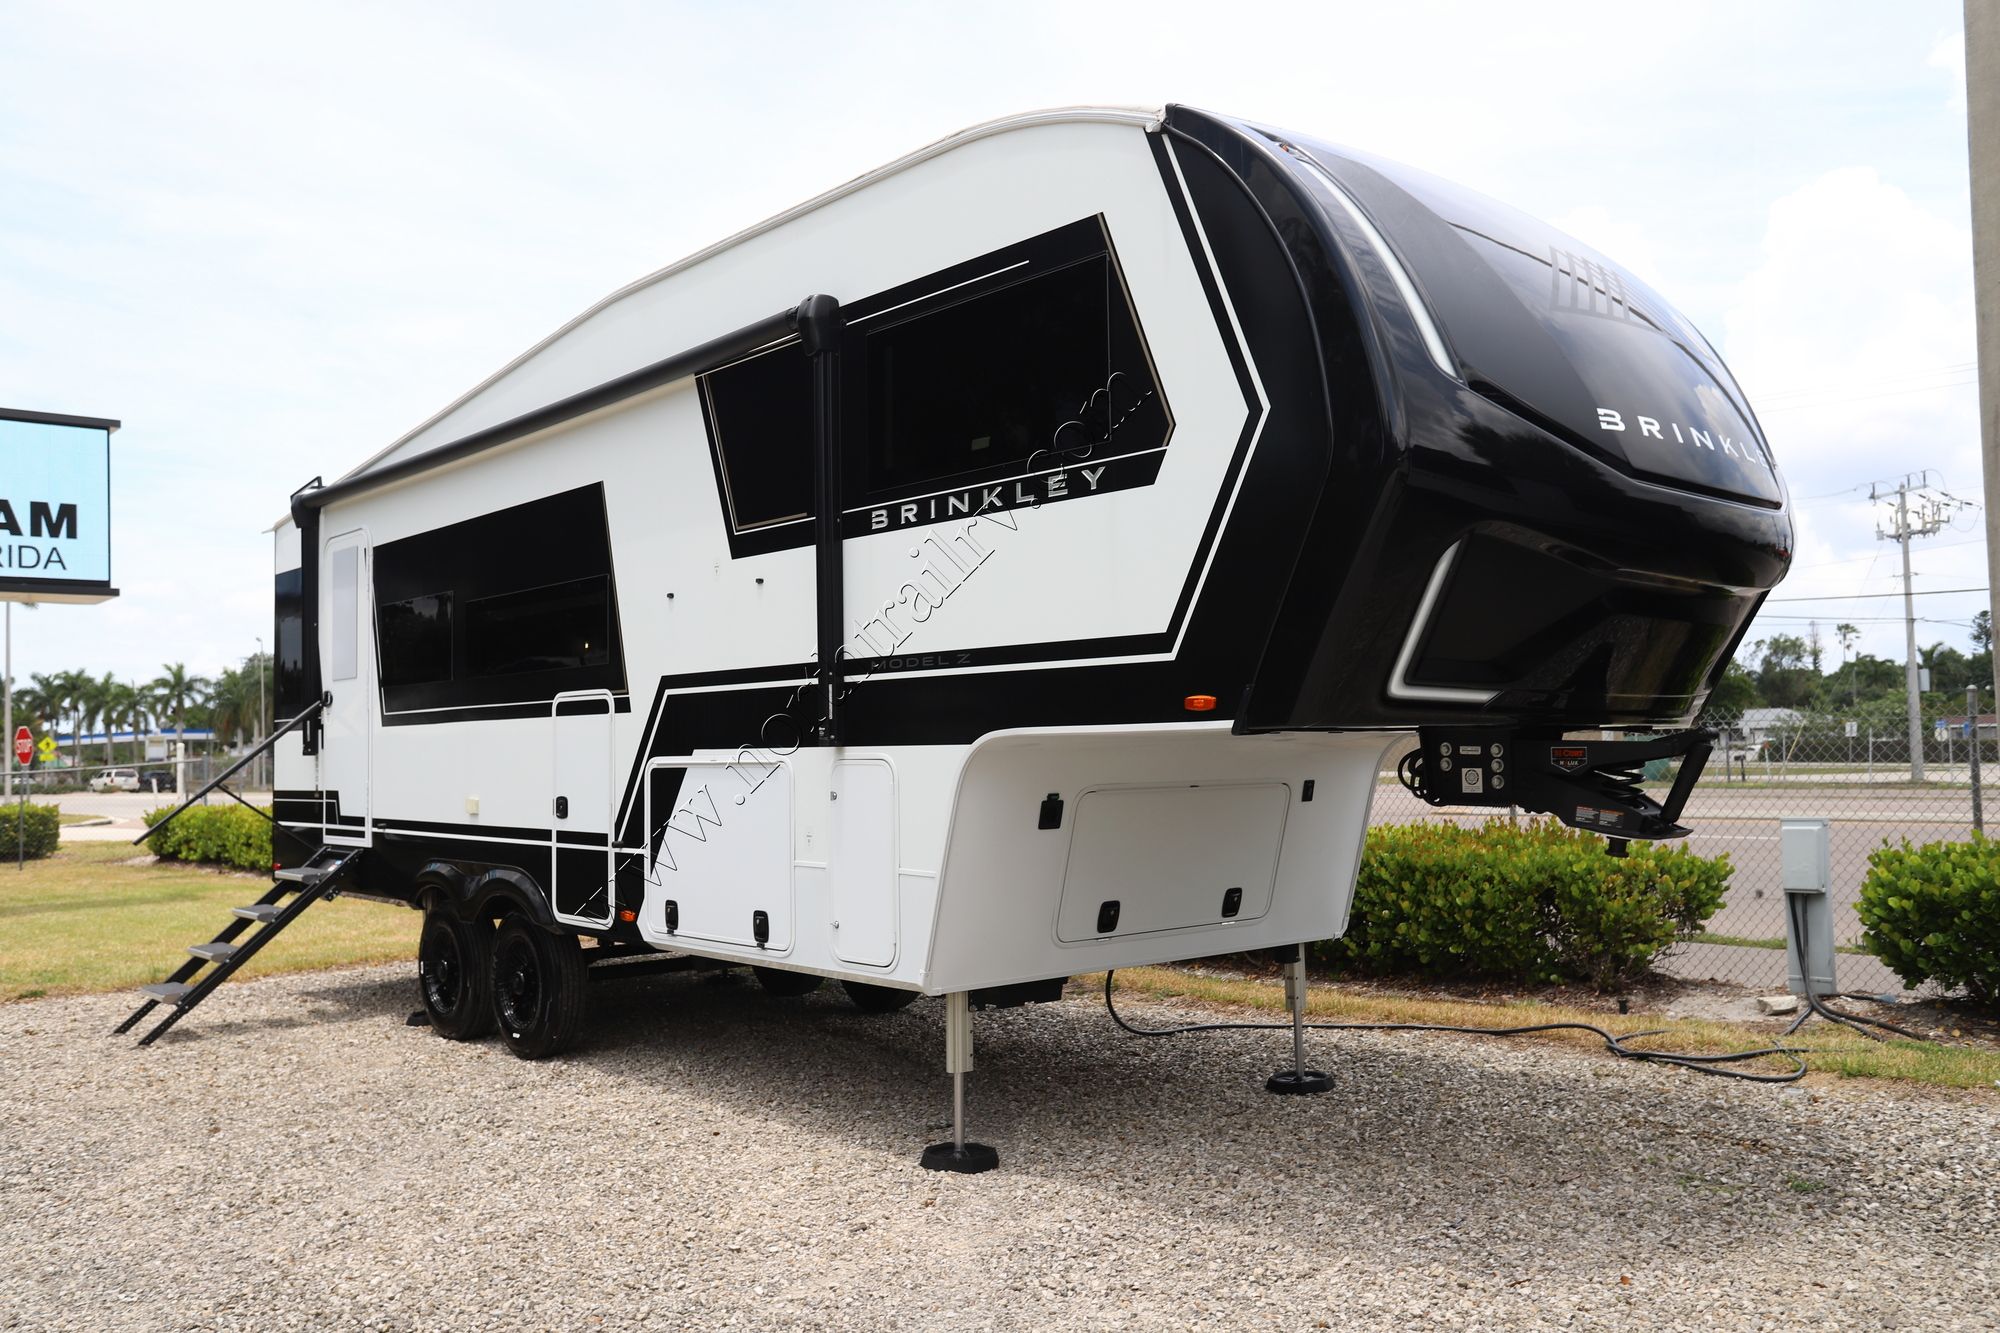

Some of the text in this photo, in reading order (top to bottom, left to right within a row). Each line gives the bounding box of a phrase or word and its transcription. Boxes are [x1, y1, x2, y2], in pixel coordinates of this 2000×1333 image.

[871, 466, 1106, 530] BRINKLEY
[0, 544, 67, 571] IDA
[870, 653, 971, 670] MODEL Z
